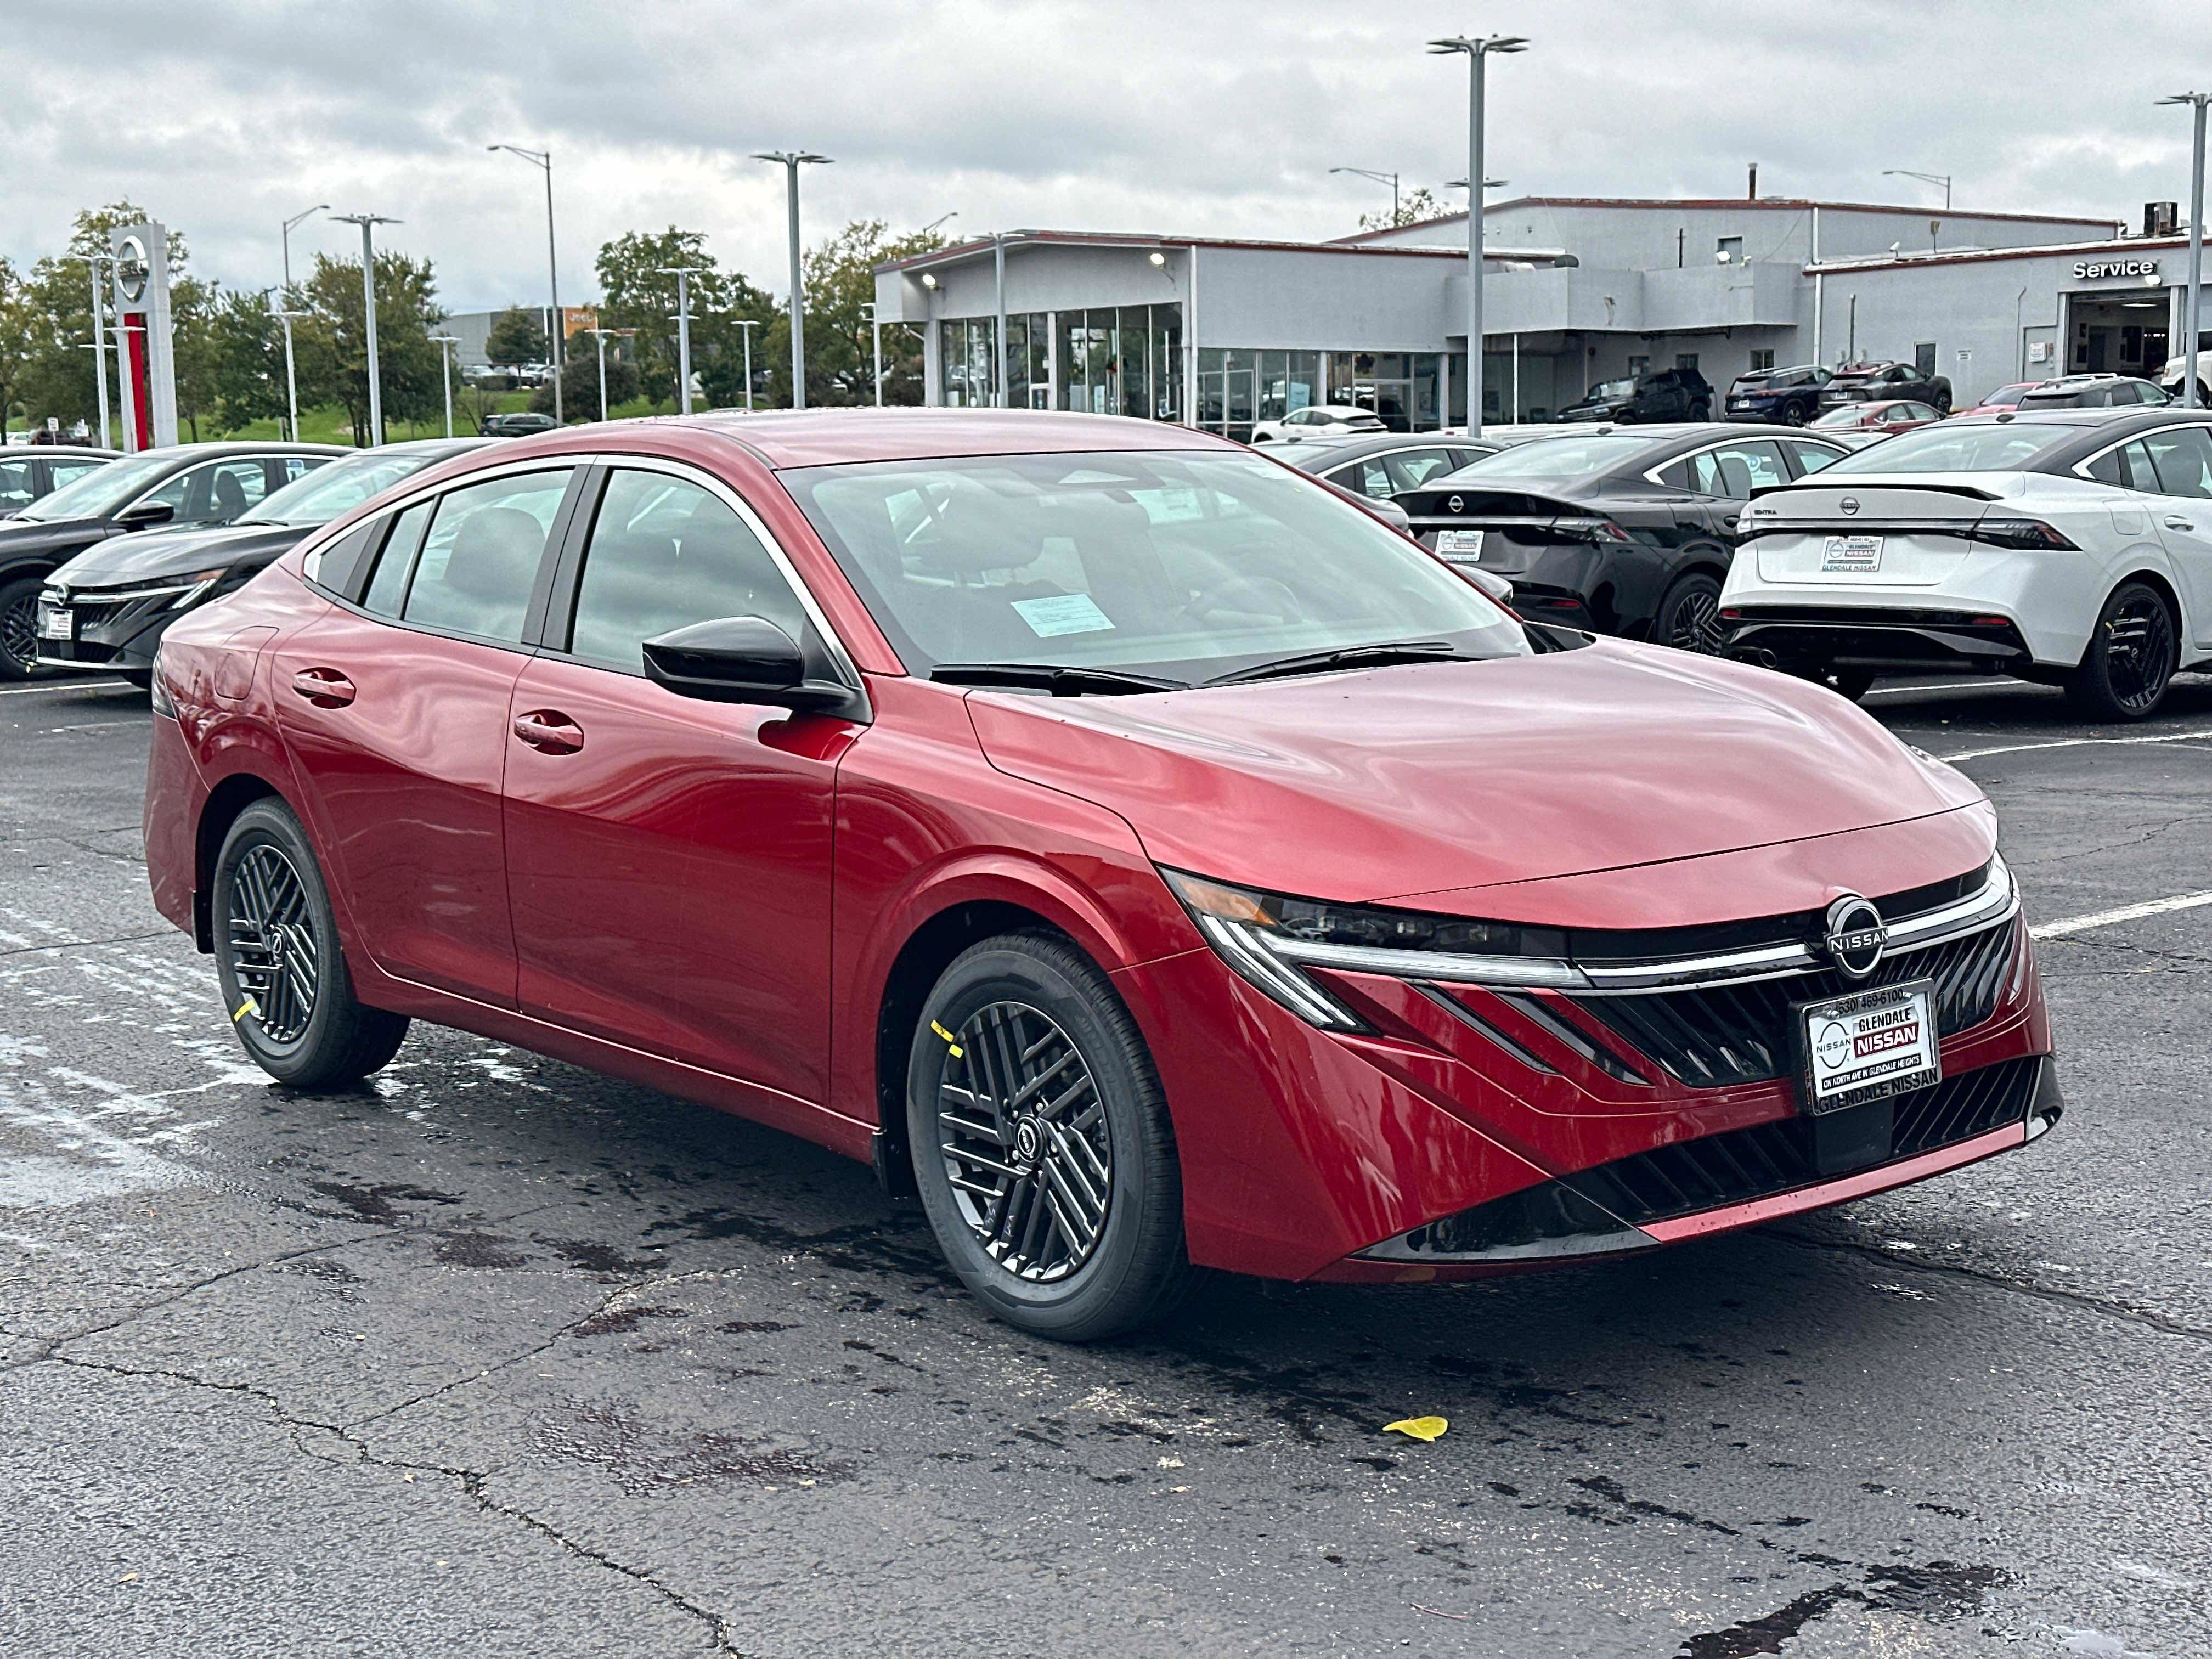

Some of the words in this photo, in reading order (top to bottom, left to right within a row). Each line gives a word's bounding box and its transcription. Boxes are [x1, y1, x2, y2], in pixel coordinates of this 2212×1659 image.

[2073, 259, 2153, 279] Service
[1831, 930, 1888, 951] NISSAN
[1861, 989, 1903, 1009] 469-6100
[1859, 1007, 1911, 1032] GLENDALE
[1816, 1037, 1852, 1053] NISSAN
[1857, 1025, 1917, 1055] NISSAN
[1824, 1079, 1832, 1088] ON
[1832, 1075, 1850, 1086] NORTH
[1851, 1071, 1861, 1081] AVE
[1862, 1069, 1868, 1077] IN
[1869, 1062, 1897, 1075] GLENDALE
[1897, 1056, 1920, 1069] HEIGHTS
[1819, 1084, 1889, 1111] GLENDALE
[1892, 1070, 1939, 1094] NISSAN
